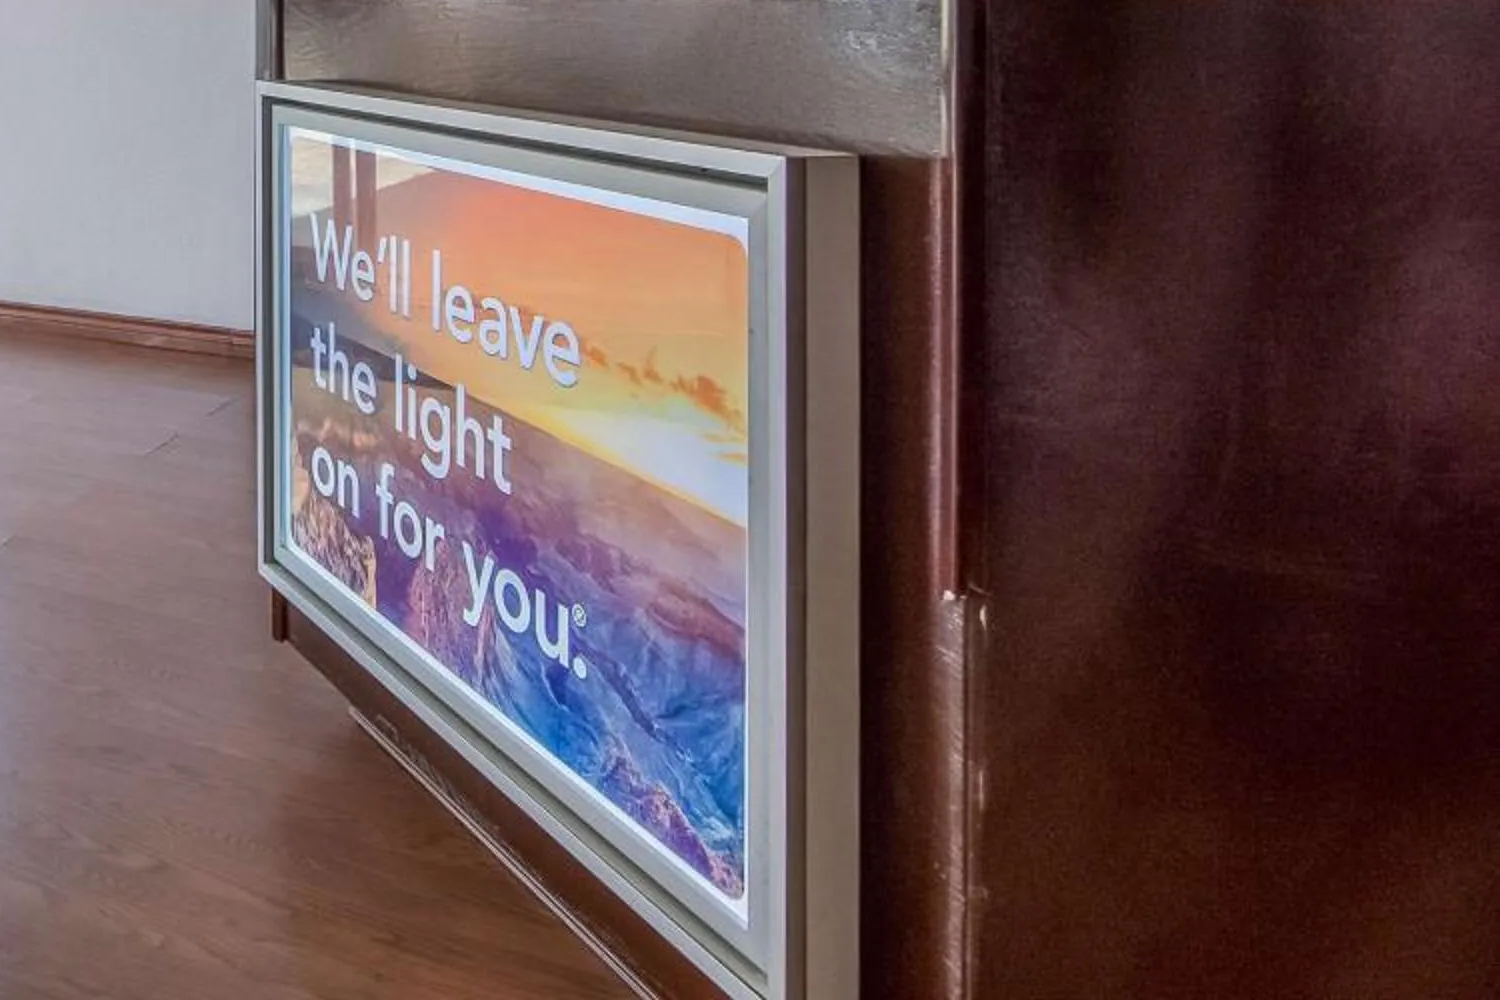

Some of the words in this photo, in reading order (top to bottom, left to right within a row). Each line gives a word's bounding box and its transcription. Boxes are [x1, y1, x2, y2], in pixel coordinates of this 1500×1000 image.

[309, 213, 411, 318] We'll
[431, 248, 581, 388] leave
[311, 322, 378, 415] the
[395, 353, 513, 496] light
[311, 446, 360, 519] on
[375, 462, 445, 571] for
